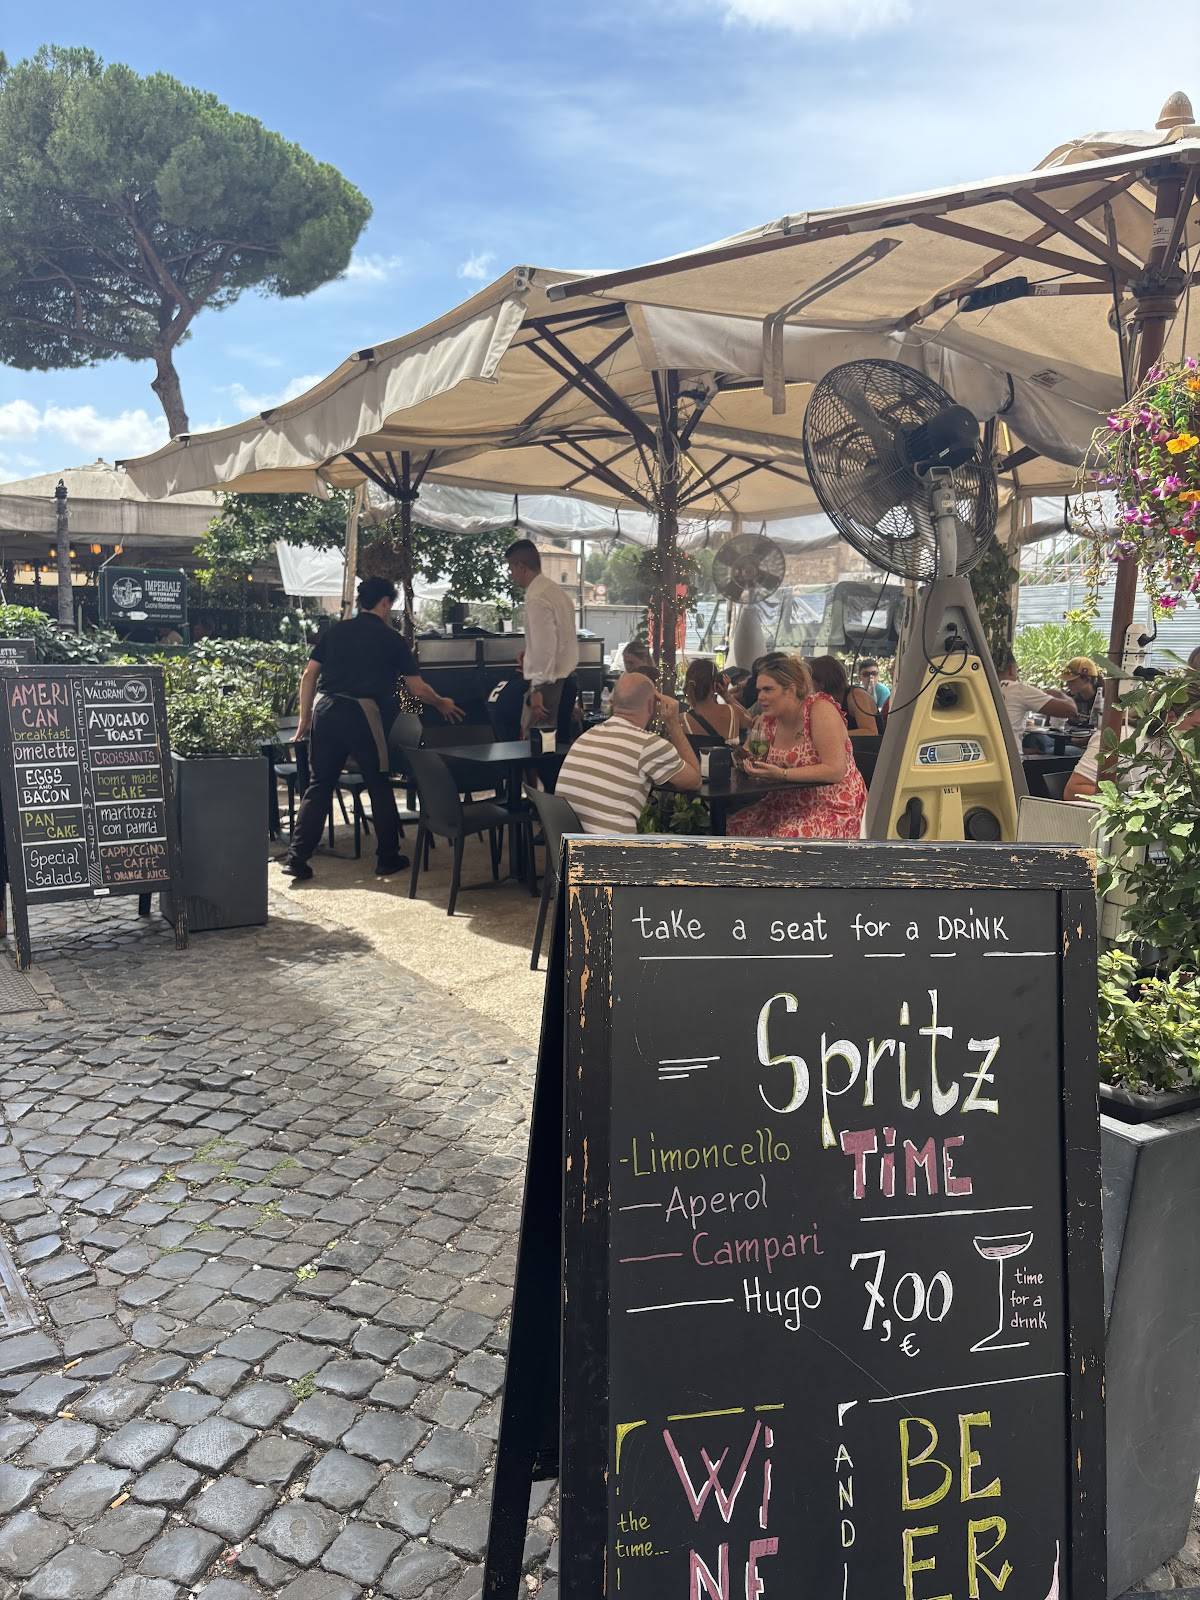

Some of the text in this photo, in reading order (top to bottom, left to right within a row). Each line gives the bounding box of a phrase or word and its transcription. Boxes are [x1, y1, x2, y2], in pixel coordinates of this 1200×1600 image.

[145, 580, 182, 593] IMPERIALE
[12, 682, 69, 707] AMERI
[85, 686, 124, 699] VALORANI
[22, 708, 59, 728] CAN
[89, 710, 150, 729] AVOCADO
[13, 726, 71, 741] breakfast
[104, 728, 144, 741] TOAST
[15, 742, 76, 761] omelette
[25, 768, 63, 785] EGGS
[97, 770, 159, 785] home made
[23, 788, 70, 804] BACON
[112, 786, 146, 799] CAKE
[25, 812, 55, 827] PAN
[100, 804, 158, 821] maritozzi
[46, 824, 79, 838] CAKE
[102, 821, 158, 838] con panna
[30, 848, 80, 870] Special
[35, 866, 83, 886] Salads
[632, 907, 705, 940] take
[733, 918, 747, 941] a
[770, 912, 828, 941] seat
[850, 913, 891, 941] for
[905, 919, 920, 941] a
[756, 989, 1001, 1149] Spritz
[665, 1174, 769, 1229] Aperol
[692, 1223, 825, 1274] Campari
[1013, 1266, 1045, 1285] time
[743, 1276, 822, 1331] Hugo
[849, 1250, 954, 1358] 7,00 €
[1009, 1289, 1043, 1308] for a
[1010, 1311, 1048, 1330] drink
[898, 1411, 1002, 1512] BE
[616, 1511, 651, 1533] the
